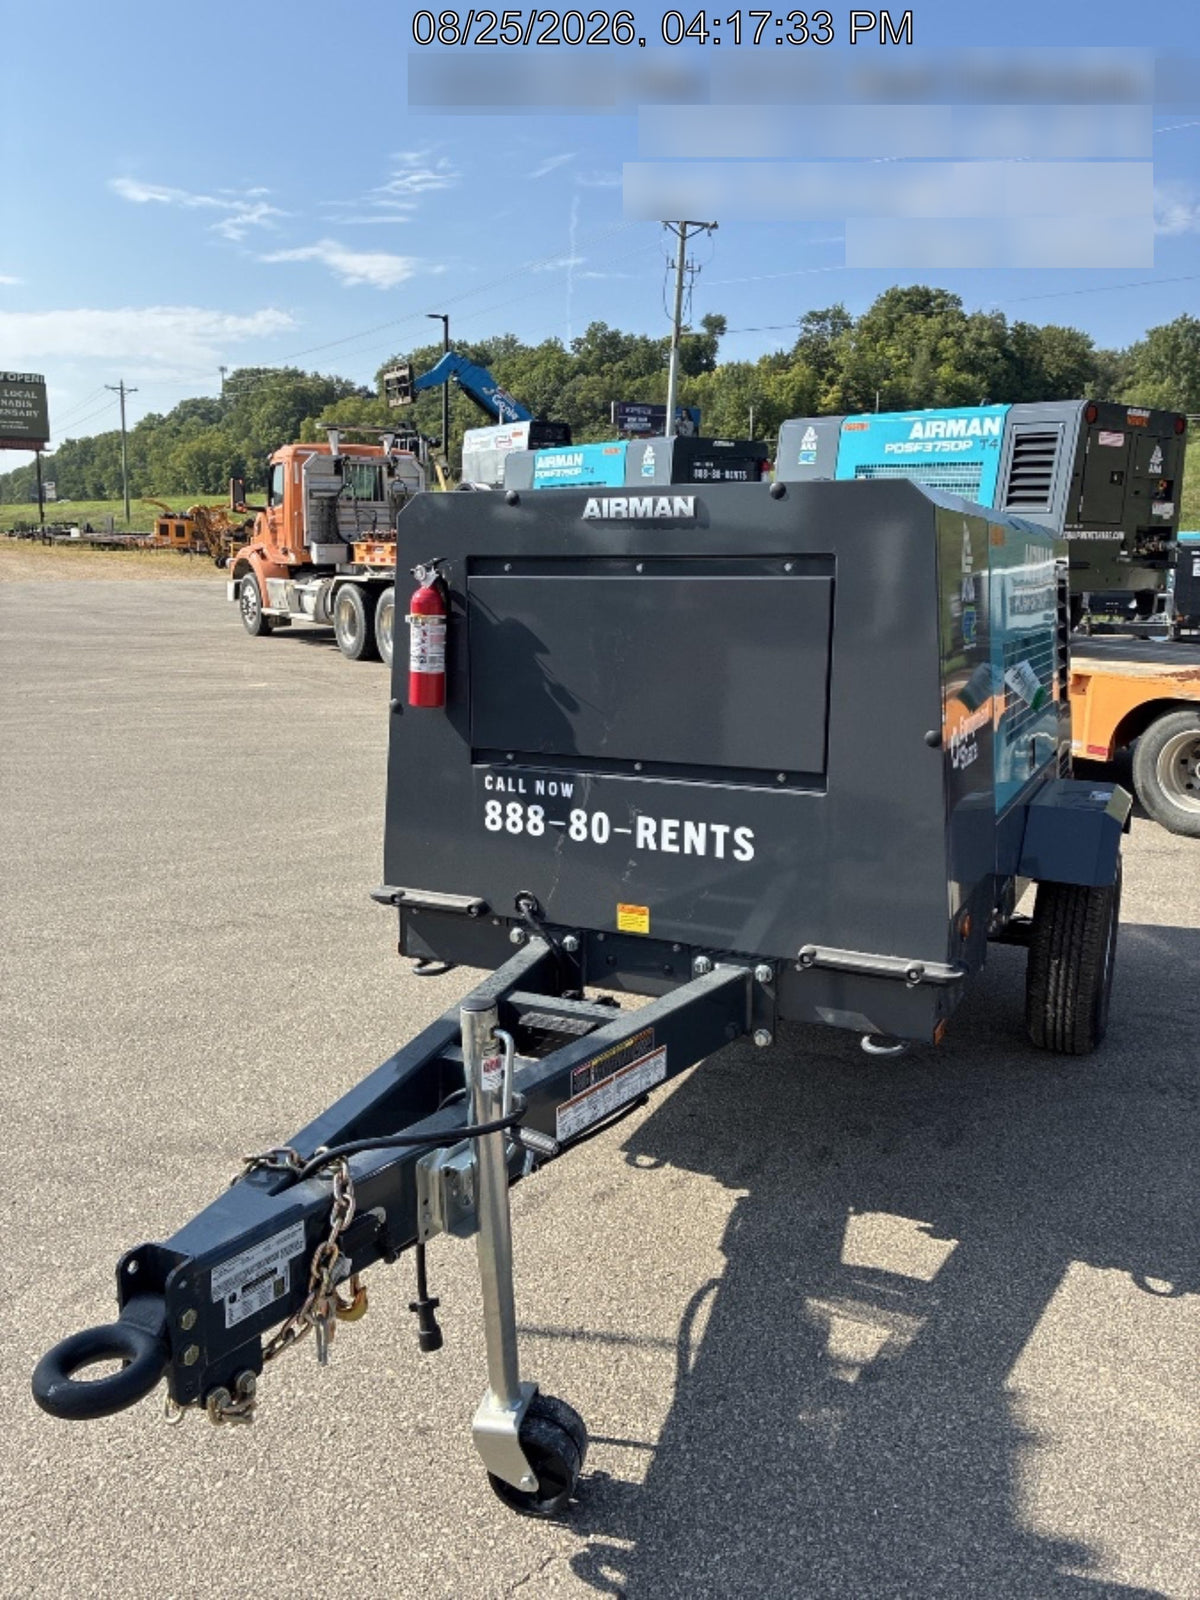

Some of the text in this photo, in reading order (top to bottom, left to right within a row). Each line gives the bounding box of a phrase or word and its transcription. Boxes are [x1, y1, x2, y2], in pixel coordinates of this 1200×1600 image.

[909, 416, 1001, 440] AIRMAN
[537, 452, 584, 470] AIRMAN
[581, 495, 696, 520] AIRMAN
[484, 775, 574, 798] CALL NOW
[484, 800, 755, 861] 888-80-RENTS
